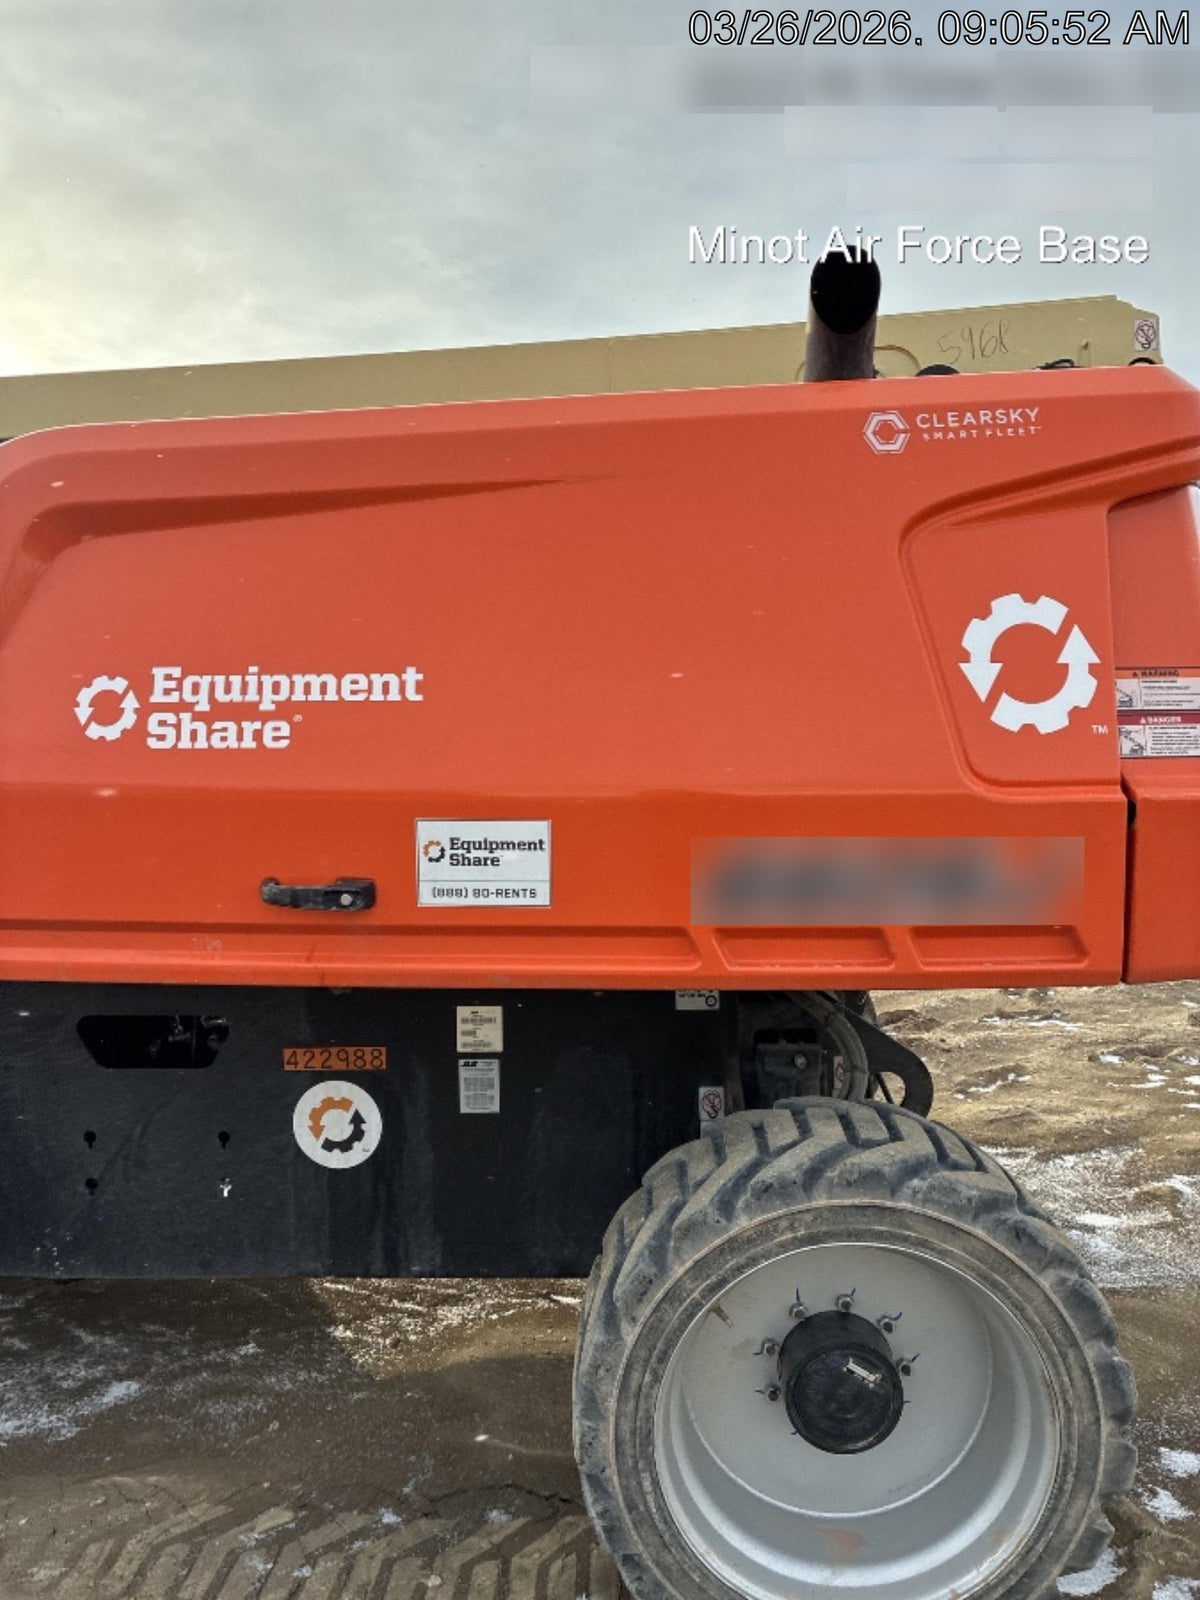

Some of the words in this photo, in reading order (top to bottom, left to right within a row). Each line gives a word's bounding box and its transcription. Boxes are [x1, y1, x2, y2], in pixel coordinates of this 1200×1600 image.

[915, 406, 1040, 429] CLEARSKY
[921, 429, 978, 442] SMART
[985, 426, 1037, 437] FLEET
[149, 665, 424, 712] Equipment
[146, 711, 292, 750] Share
[448, 837, 546, 854] Equipment
[449, 853, 501, 867] Share
[432, 886, 468, 899] (888)
[472, 887, 537, 899] 80-RENTS
[285, 1048, 384, 1070] 422988
